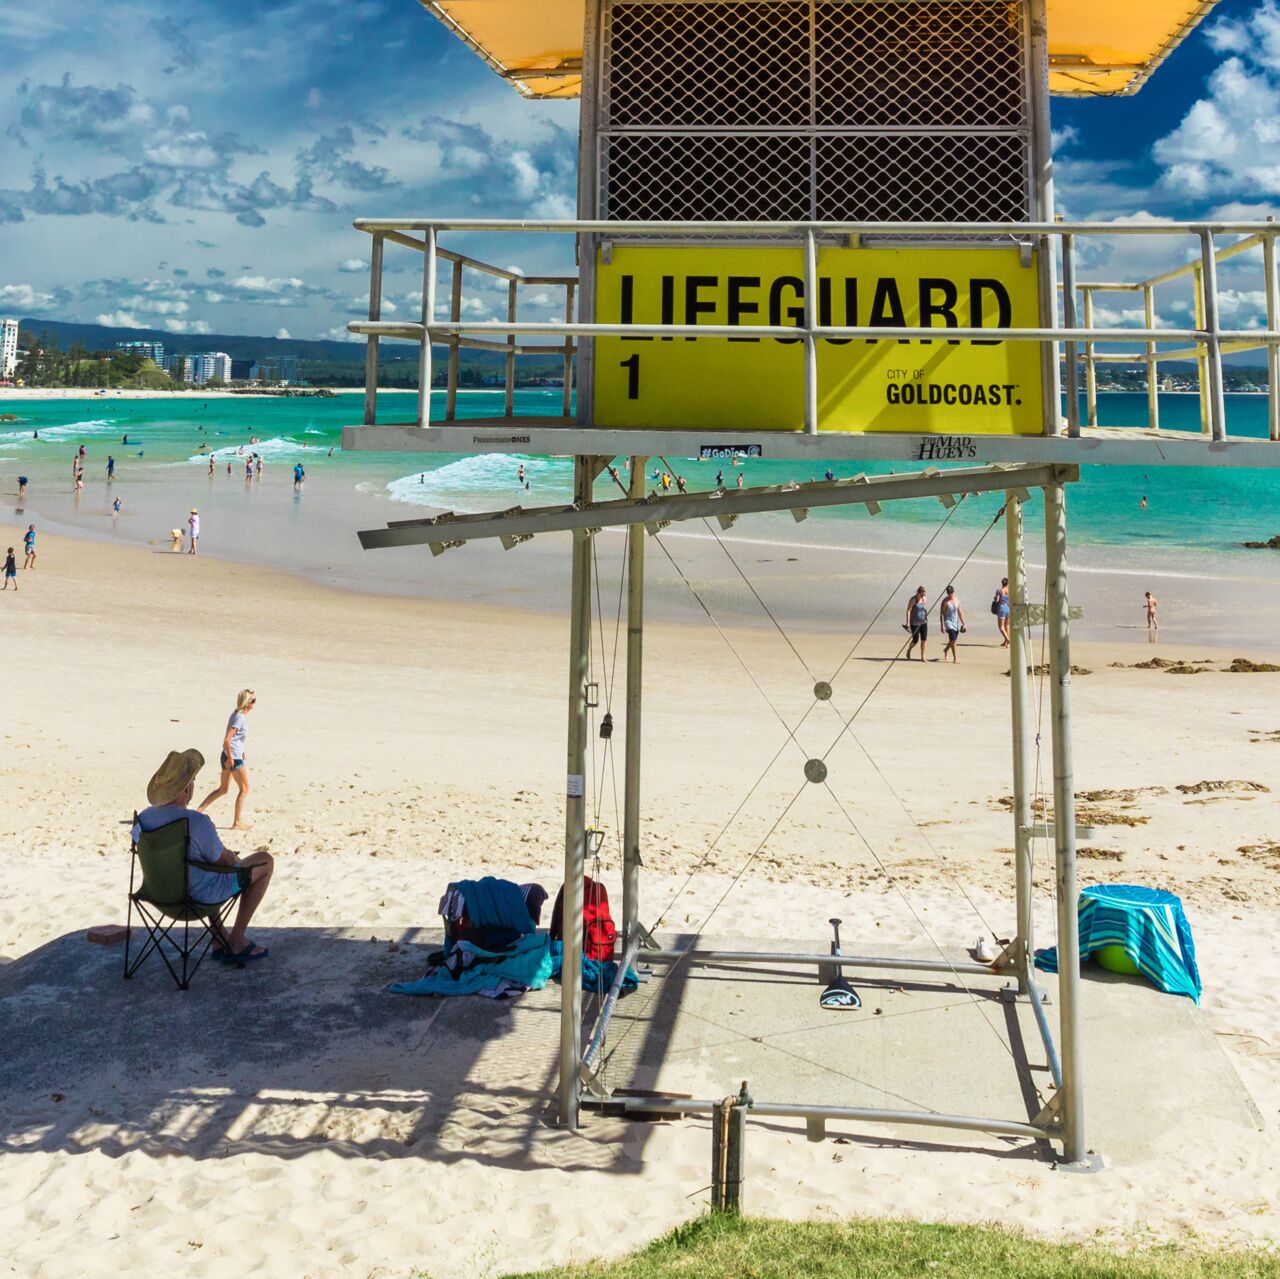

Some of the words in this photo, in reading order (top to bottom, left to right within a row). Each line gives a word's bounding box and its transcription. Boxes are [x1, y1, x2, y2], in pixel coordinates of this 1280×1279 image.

[621, 275, 1012, 345] LIFEGUARD
[620, 353, 640, 400] 1
[887, 369, 908, 379] CITY
[913, 369, 925, 380] OF
[935, 435, 971, 447] MAD
[919, 444, 977, 461] HUEY'S
